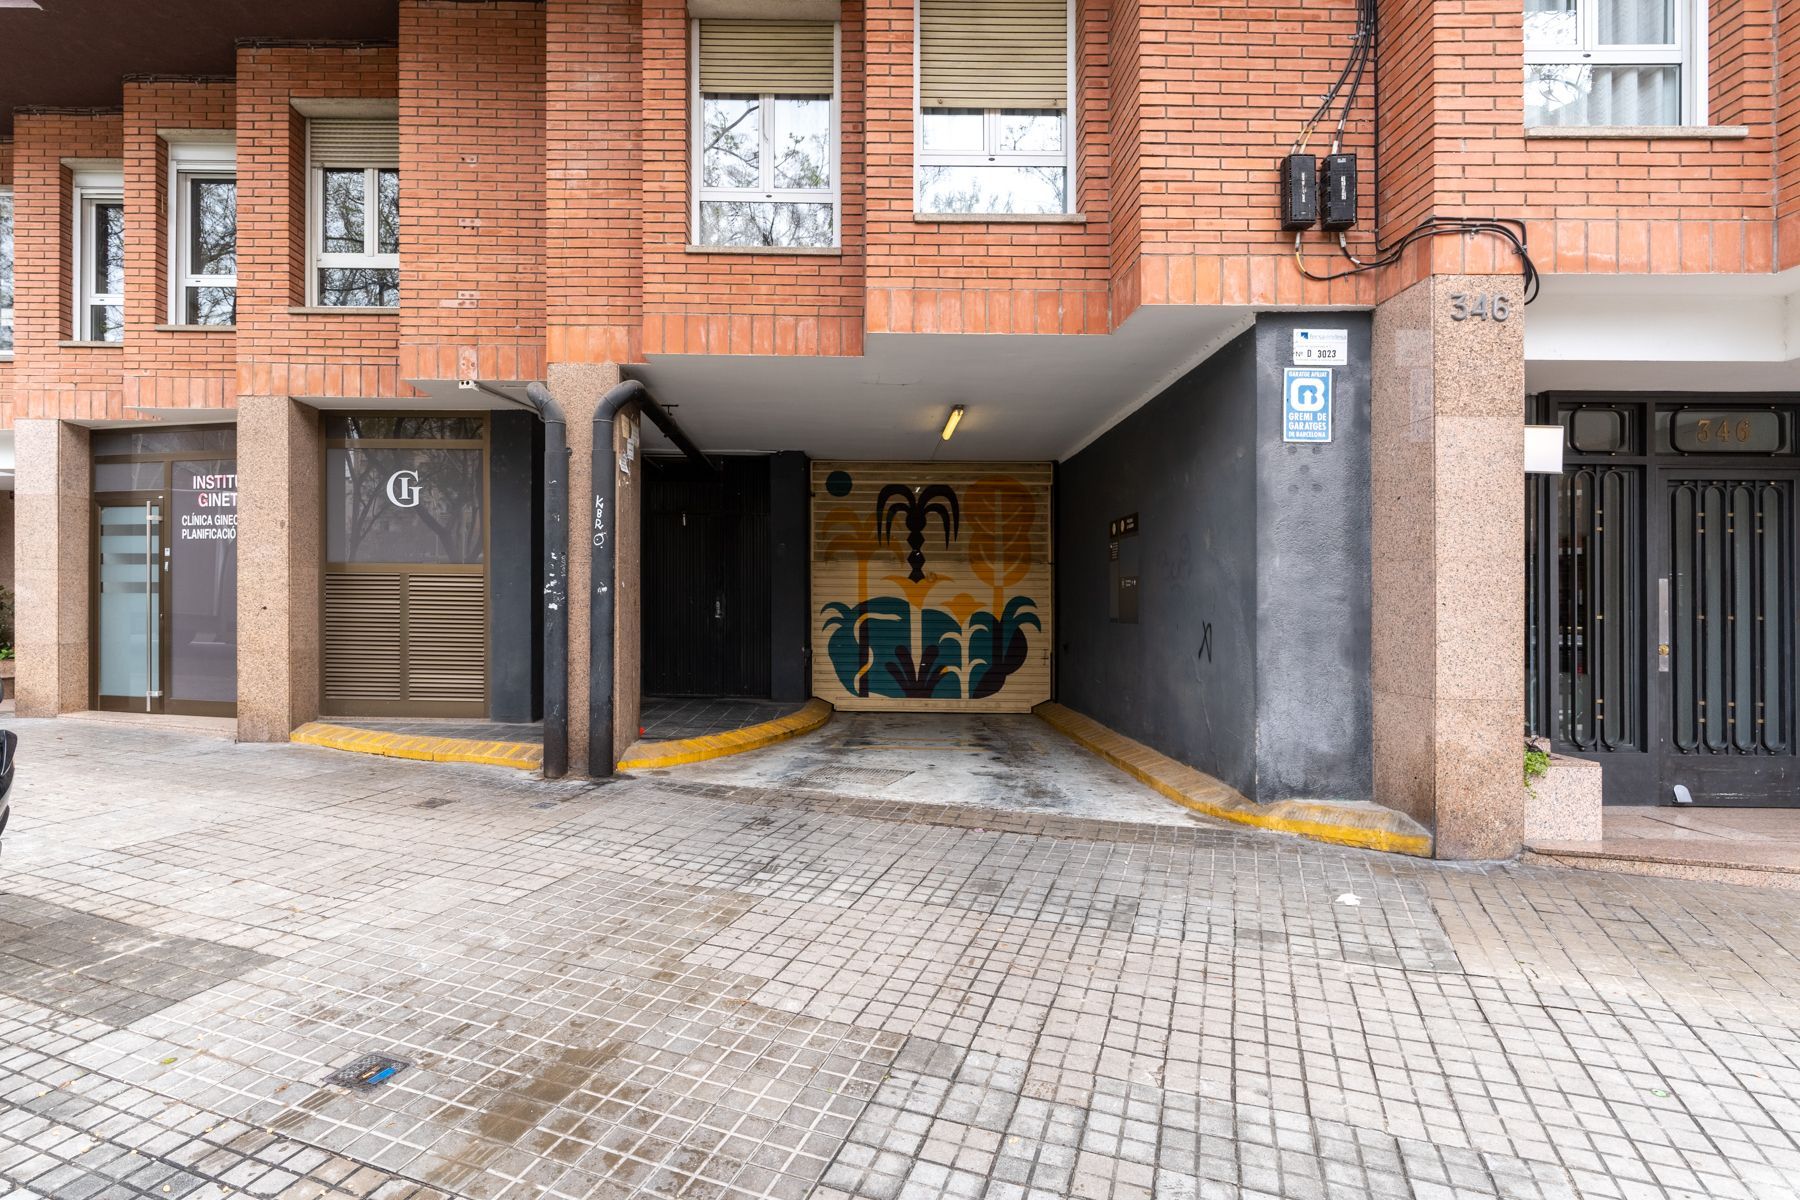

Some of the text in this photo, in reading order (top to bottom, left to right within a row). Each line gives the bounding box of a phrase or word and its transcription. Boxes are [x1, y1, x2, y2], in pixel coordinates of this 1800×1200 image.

[1450, 293, 1509, 322] 346
[1317, 349, 1336, 358] 3023
[1289, 412, 1327, 421] GREMI DE
[1289, 421, 1327, 430] GARATGES
[1696, 419, 1750, 442] 346
[193, 474, 237, 489] INSTIT
[182, 512, 212, 525] CLÍNICA
[182, 525, 236, 539] PLANIFICACIÓ
